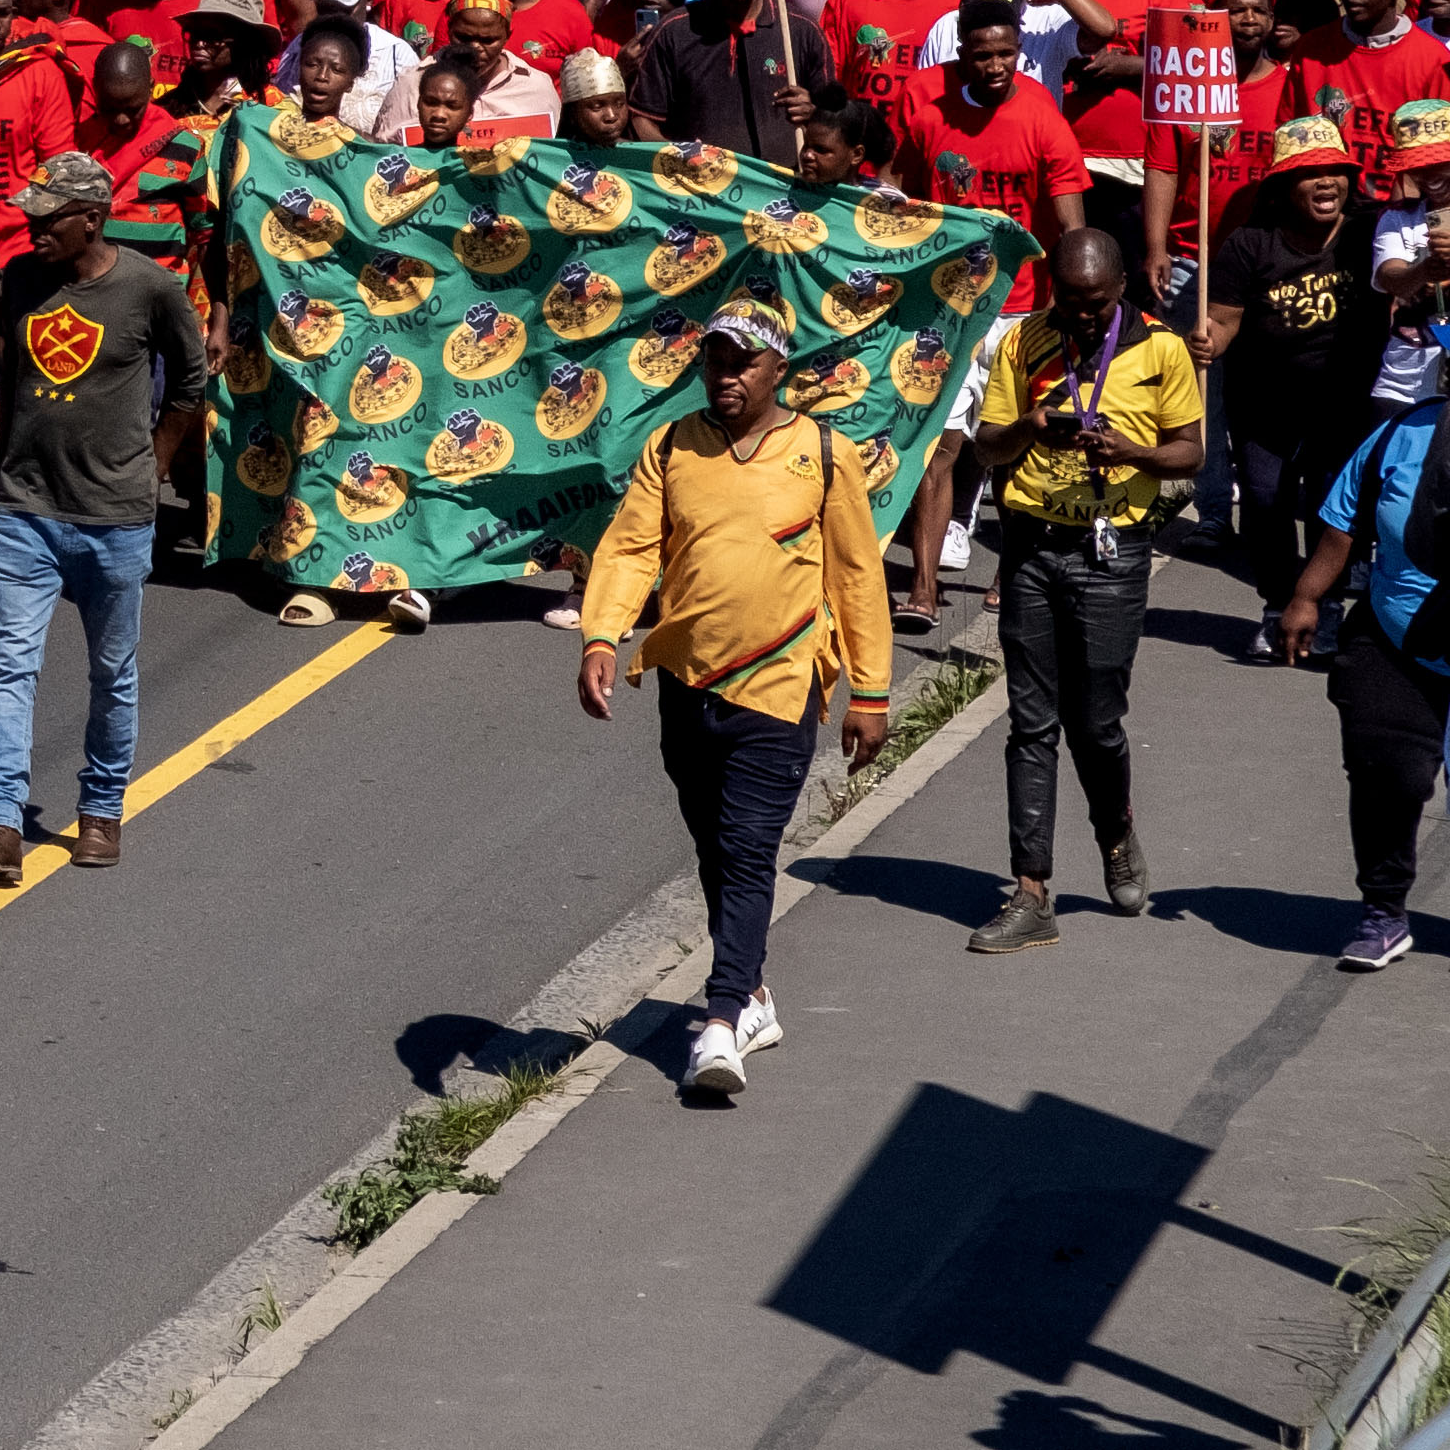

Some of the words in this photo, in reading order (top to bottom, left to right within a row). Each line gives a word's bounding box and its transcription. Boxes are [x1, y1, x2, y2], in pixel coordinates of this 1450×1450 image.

[1200, 21, 1220, 30] EFF
[1153, 83, 1240, 115] CRIME
[285, 146, 357, 180] SANCO
[981, 170, 1028, 192] EFF
[377, 195, 447, 243] SANCO
[863, 229, 949, 265] SANCO
[368, 294, 442, 336] SANCO
[46, 361, 77, 374] LAND
[285, 334, 354, 378] SANCO
[453, 356, 531, 398] SANCO
[358, 402, 428, 444] SANCO
[547, 406, 613, 459] SANCO
[346, 497, 418, 543] SANCO
